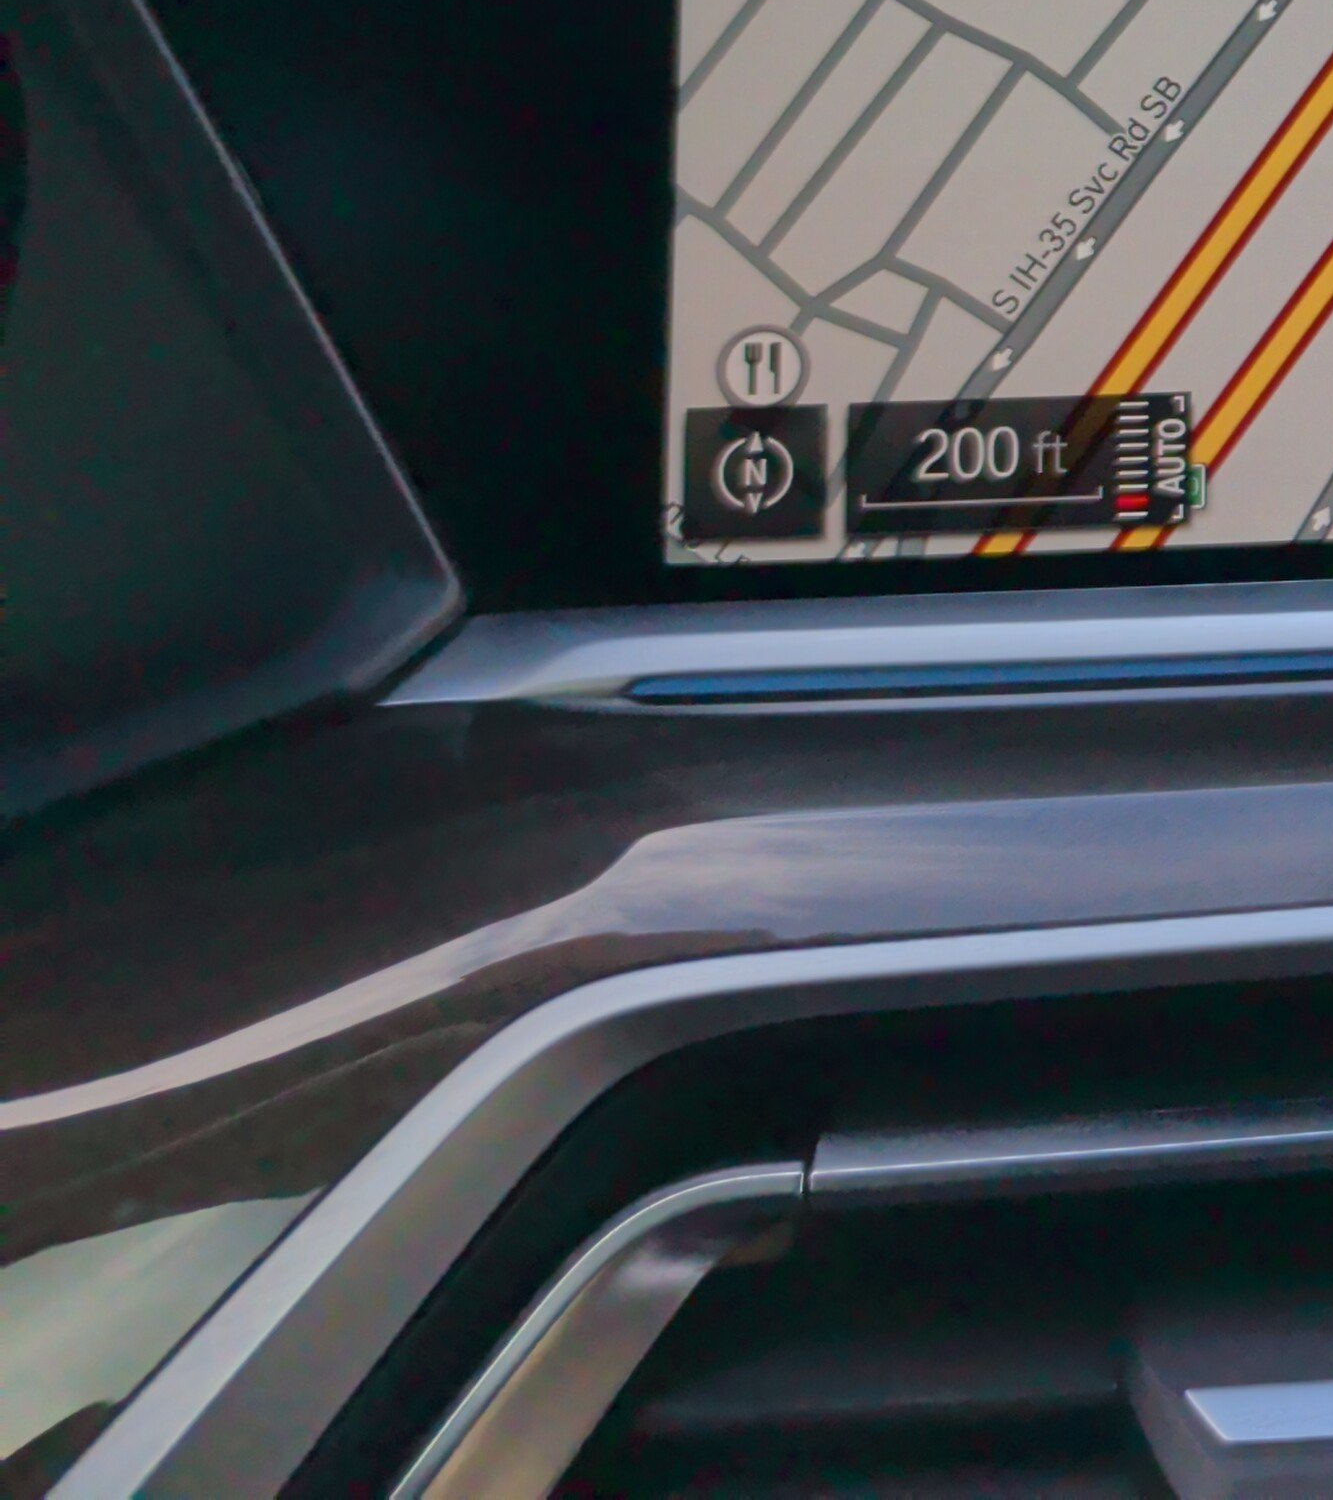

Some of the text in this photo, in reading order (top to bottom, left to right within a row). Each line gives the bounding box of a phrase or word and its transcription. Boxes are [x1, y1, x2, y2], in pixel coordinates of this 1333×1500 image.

[992, 76, 1182, 314] S IH-35 Svc Rd SB
[745, 458, 767, 487] N
[915, 426, 1068, 482] 200 ft
[1156, 418, 1186, 494] AUTO
